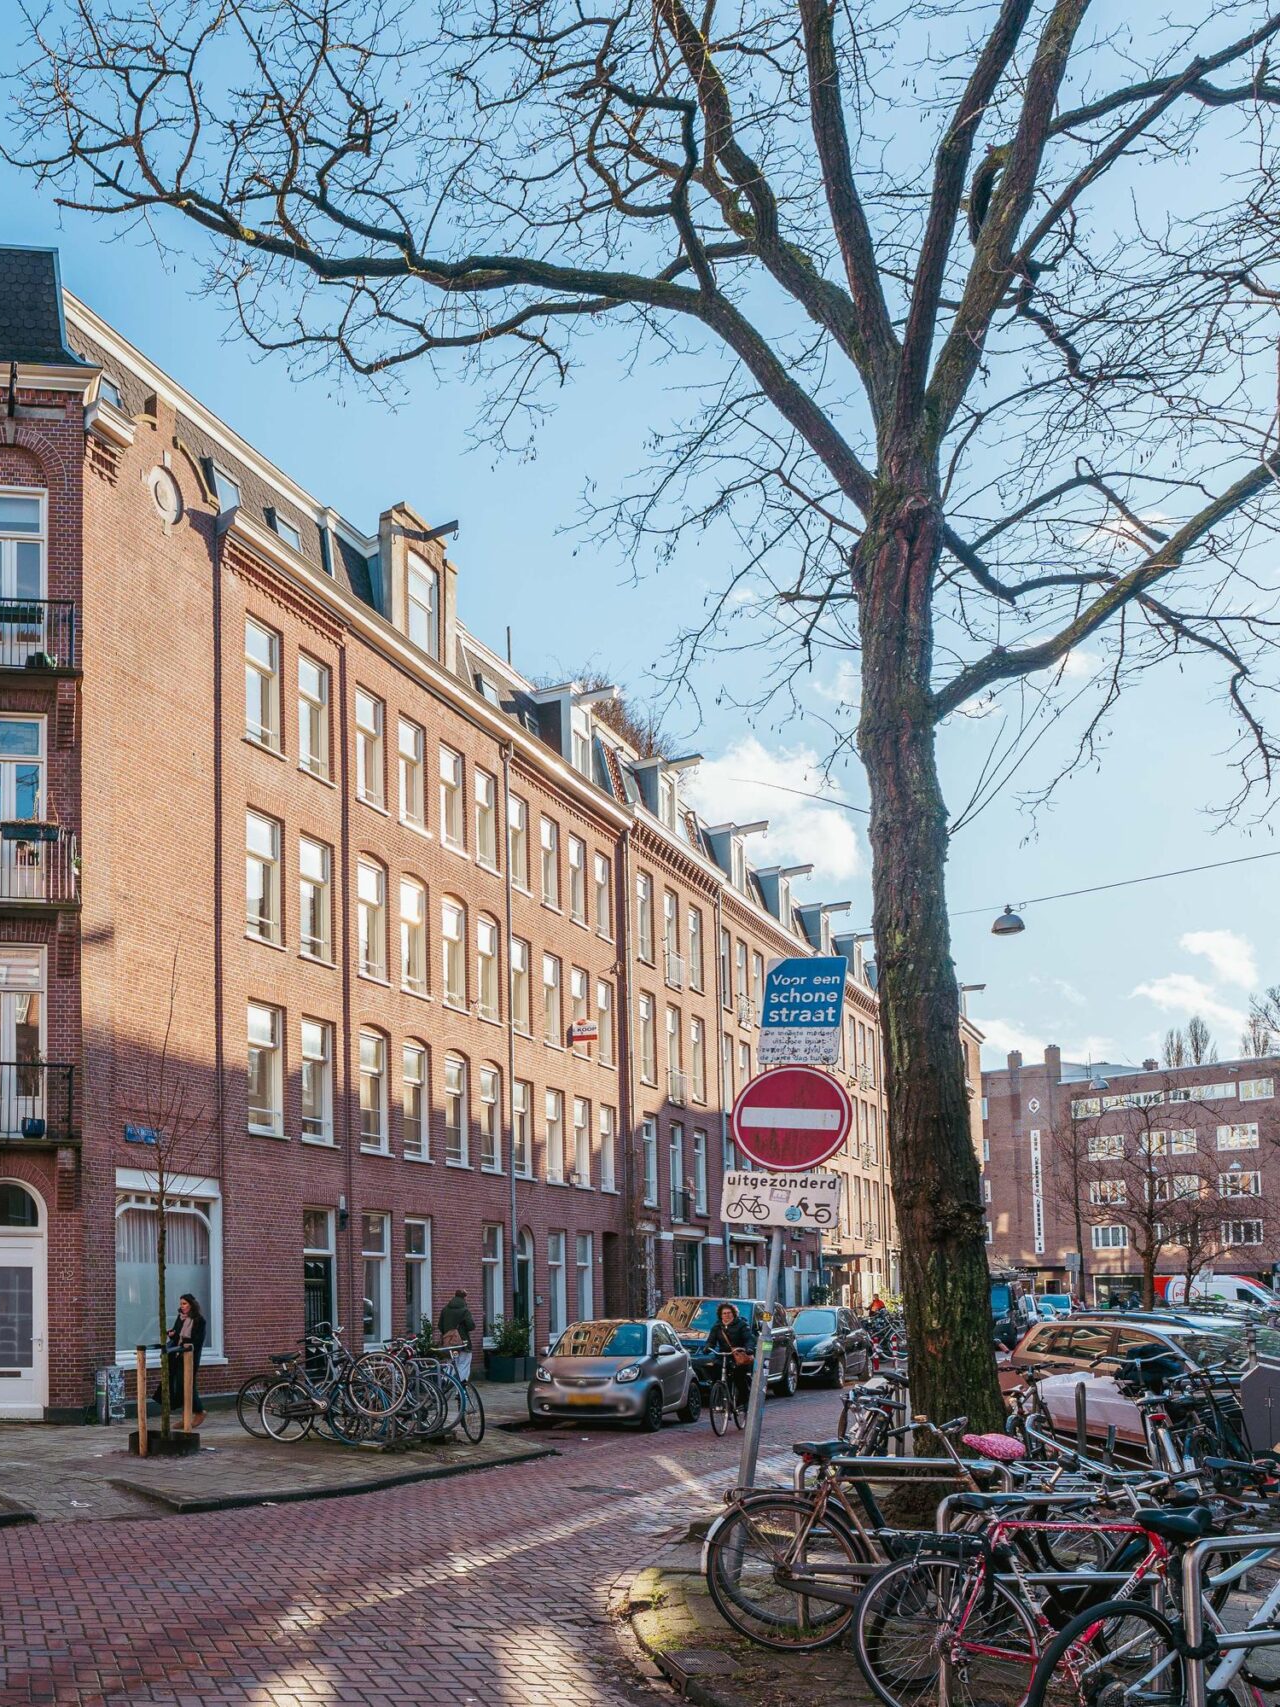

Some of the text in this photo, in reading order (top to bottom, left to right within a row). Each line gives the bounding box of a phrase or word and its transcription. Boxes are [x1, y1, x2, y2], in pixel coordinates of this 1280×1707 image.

[772, 974, 840, 985] Voor een
[770, 988, 838, 1003] schone
[769, 1007, 836, 1022] straat
[727, 1175, 837, 1190] uitgezonderd
[60, 1270, 73, 1281] 12
